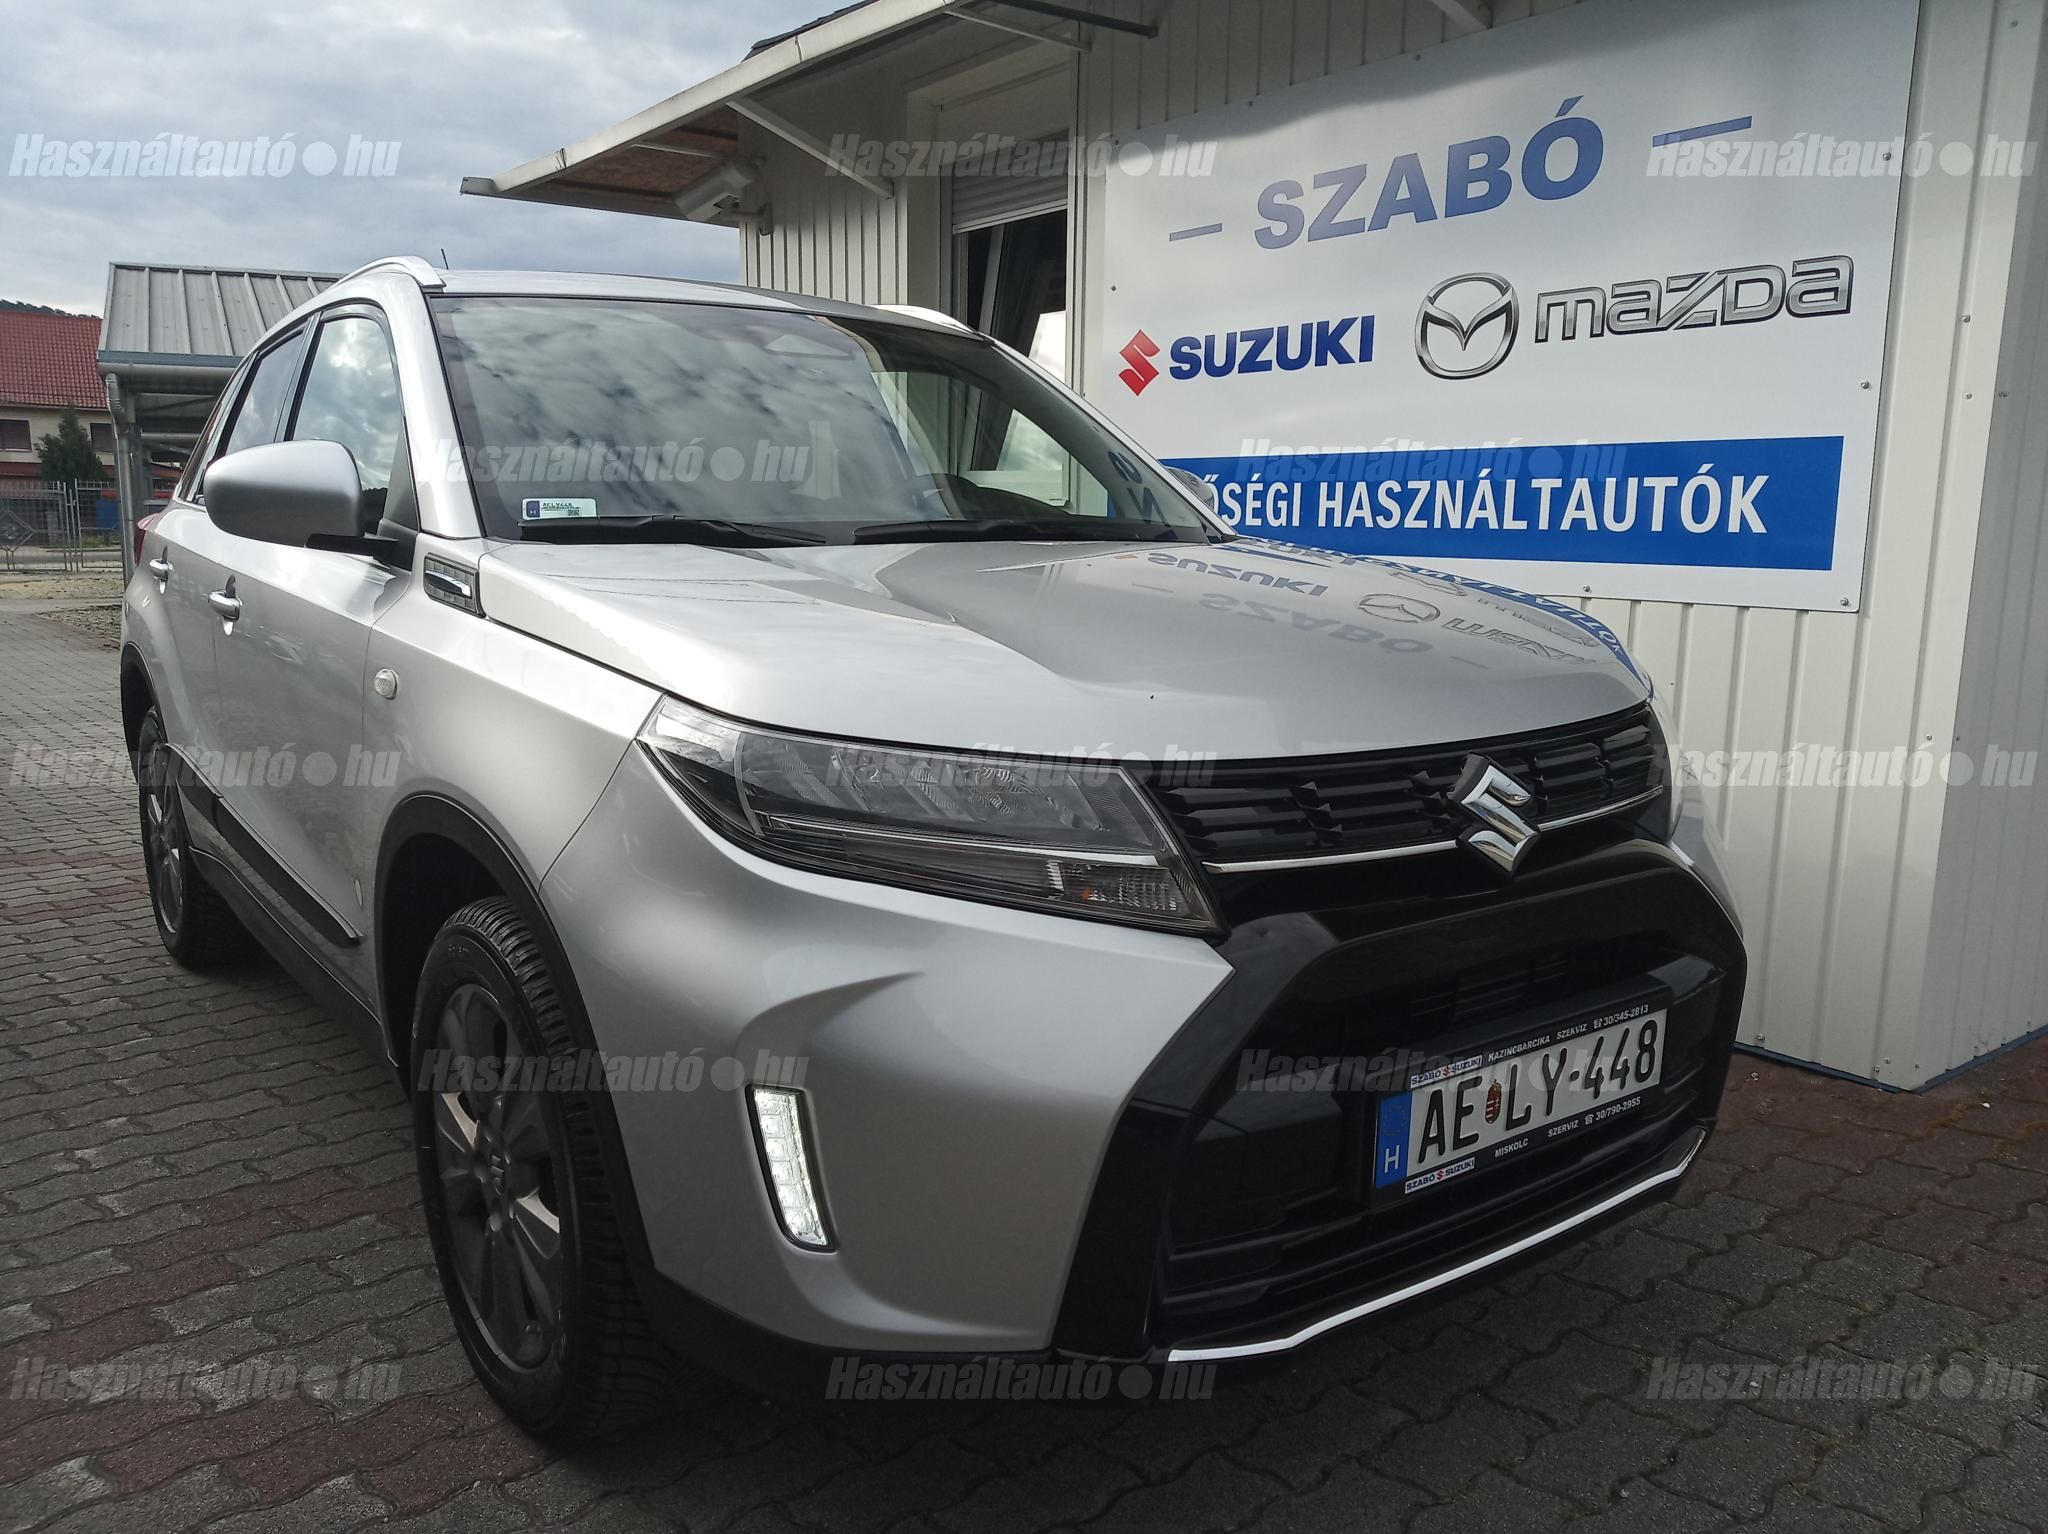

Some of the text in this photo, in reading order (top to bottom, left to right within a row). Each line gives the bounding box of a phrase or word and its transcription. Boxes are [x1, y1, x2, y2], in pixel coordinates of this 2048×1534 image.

[1254, 95, 1604, 250] SZABÓ
[1169, 315, 1375, 380] SUZUKI
[1319, 463, 1769, 535] HASZNÁLTAUTÓK
[1383, 1144, 1401, 1174] H
[1494, 1096, 1641, 1158] MISKOLC SZERVIZ 30/790-2955
